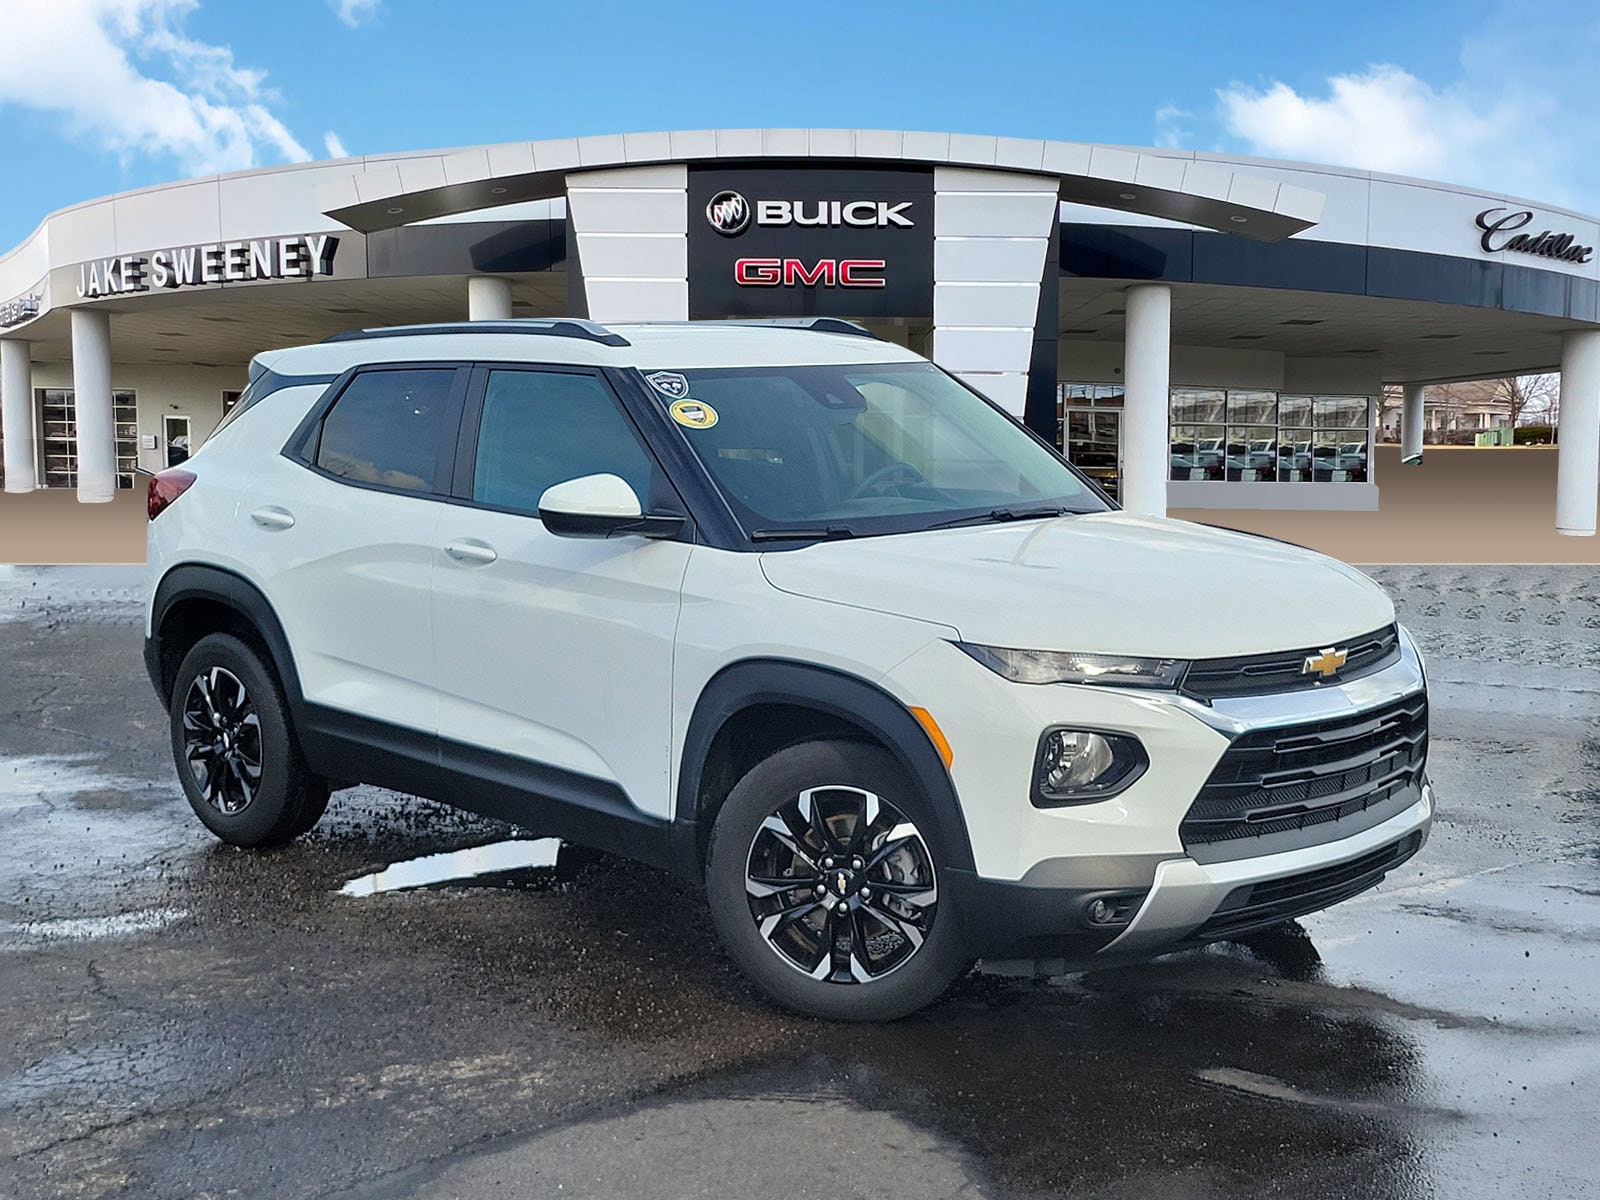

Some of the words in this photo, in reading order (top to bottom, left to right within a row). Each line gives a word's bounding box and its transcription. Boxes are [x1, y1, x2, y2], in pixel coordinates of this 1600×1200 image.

[757, 200, 915, 226] BUICK
[1475, 207, 1593, 264] Cadillac
[76, 255, 138, 299] JAKE
[151, 234, 333, 290] SWEENEY
[734, 257, 887, 287] GMC
